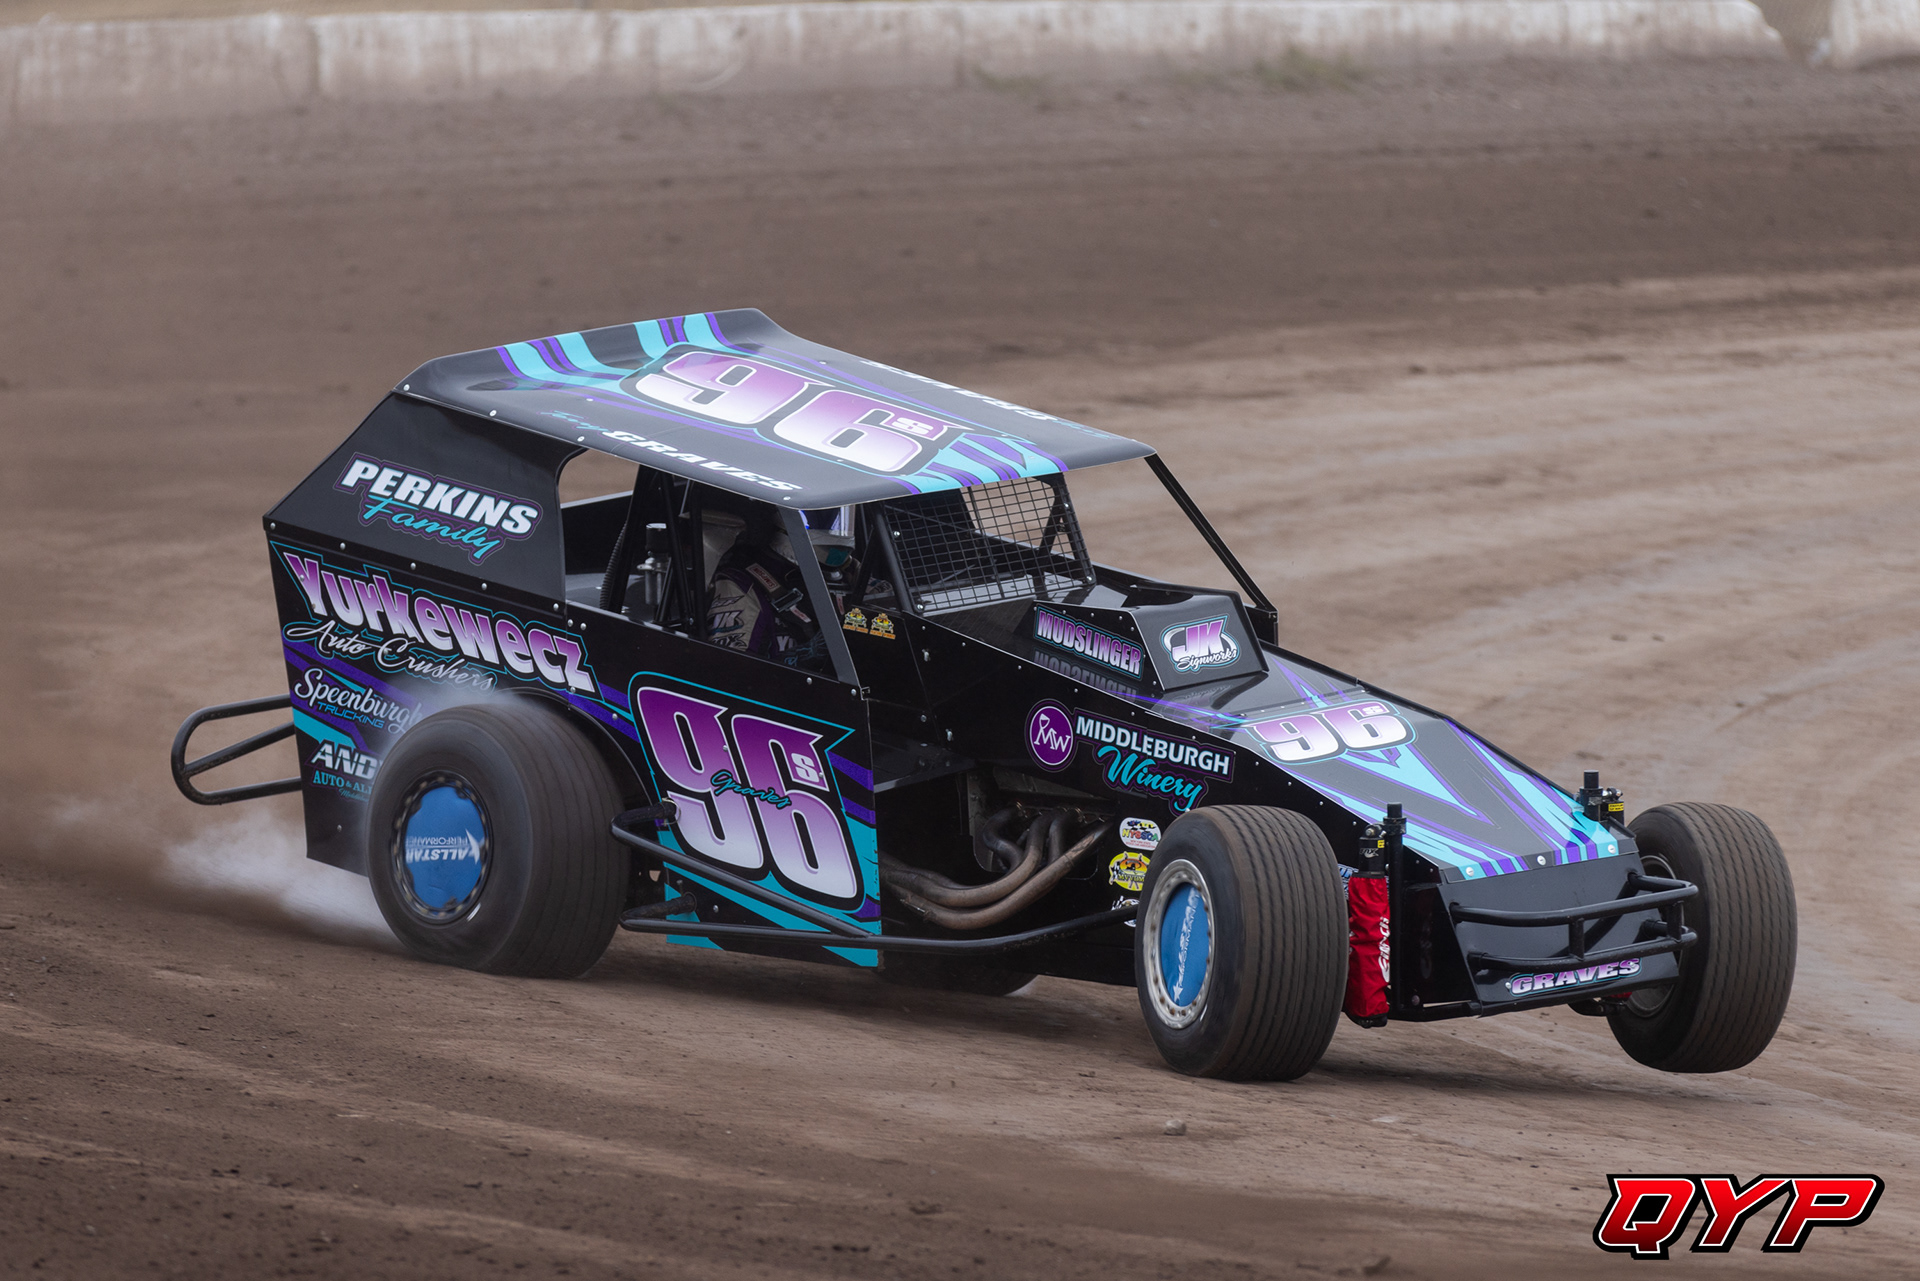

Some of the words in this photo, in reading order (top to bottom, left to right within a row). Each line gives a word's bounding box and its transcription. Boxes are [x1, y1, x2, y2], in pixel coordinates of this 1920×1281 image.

[636, 352, 942, 471] 96
[602, 430, 803, 491] GRAVES
[341, 459, 538, 534] PERKINS
[363, 494, 501, 559] Family
[283, 552, 595, 693] Yurkewecz
[1037, 610, 1142, 675] MUDSLINGER
[1172, 619, 1223, 661] JK
[287, 620, 372, 655] Auto
[377, 638, 493, 691] Crushers
[1176, 648, 1237, 671] Signworks
[318, 701, 385, 729] TRUCKING
[1242, 701, 1408, 761] 96
[310, 742, 380, 780] AND
[1076, 716, 1230, 775] MIDDLEBURGH
[312, 770, 345, 788] AUTO
[637, 686, 858, 899] 96
[711, 771, 792, 810] Graves
[1097, 745, 1202, 812] Winery
[1122, 828, 1159, 842] NYSSCA
[1511, 957, 1641, 997] GRAVES
